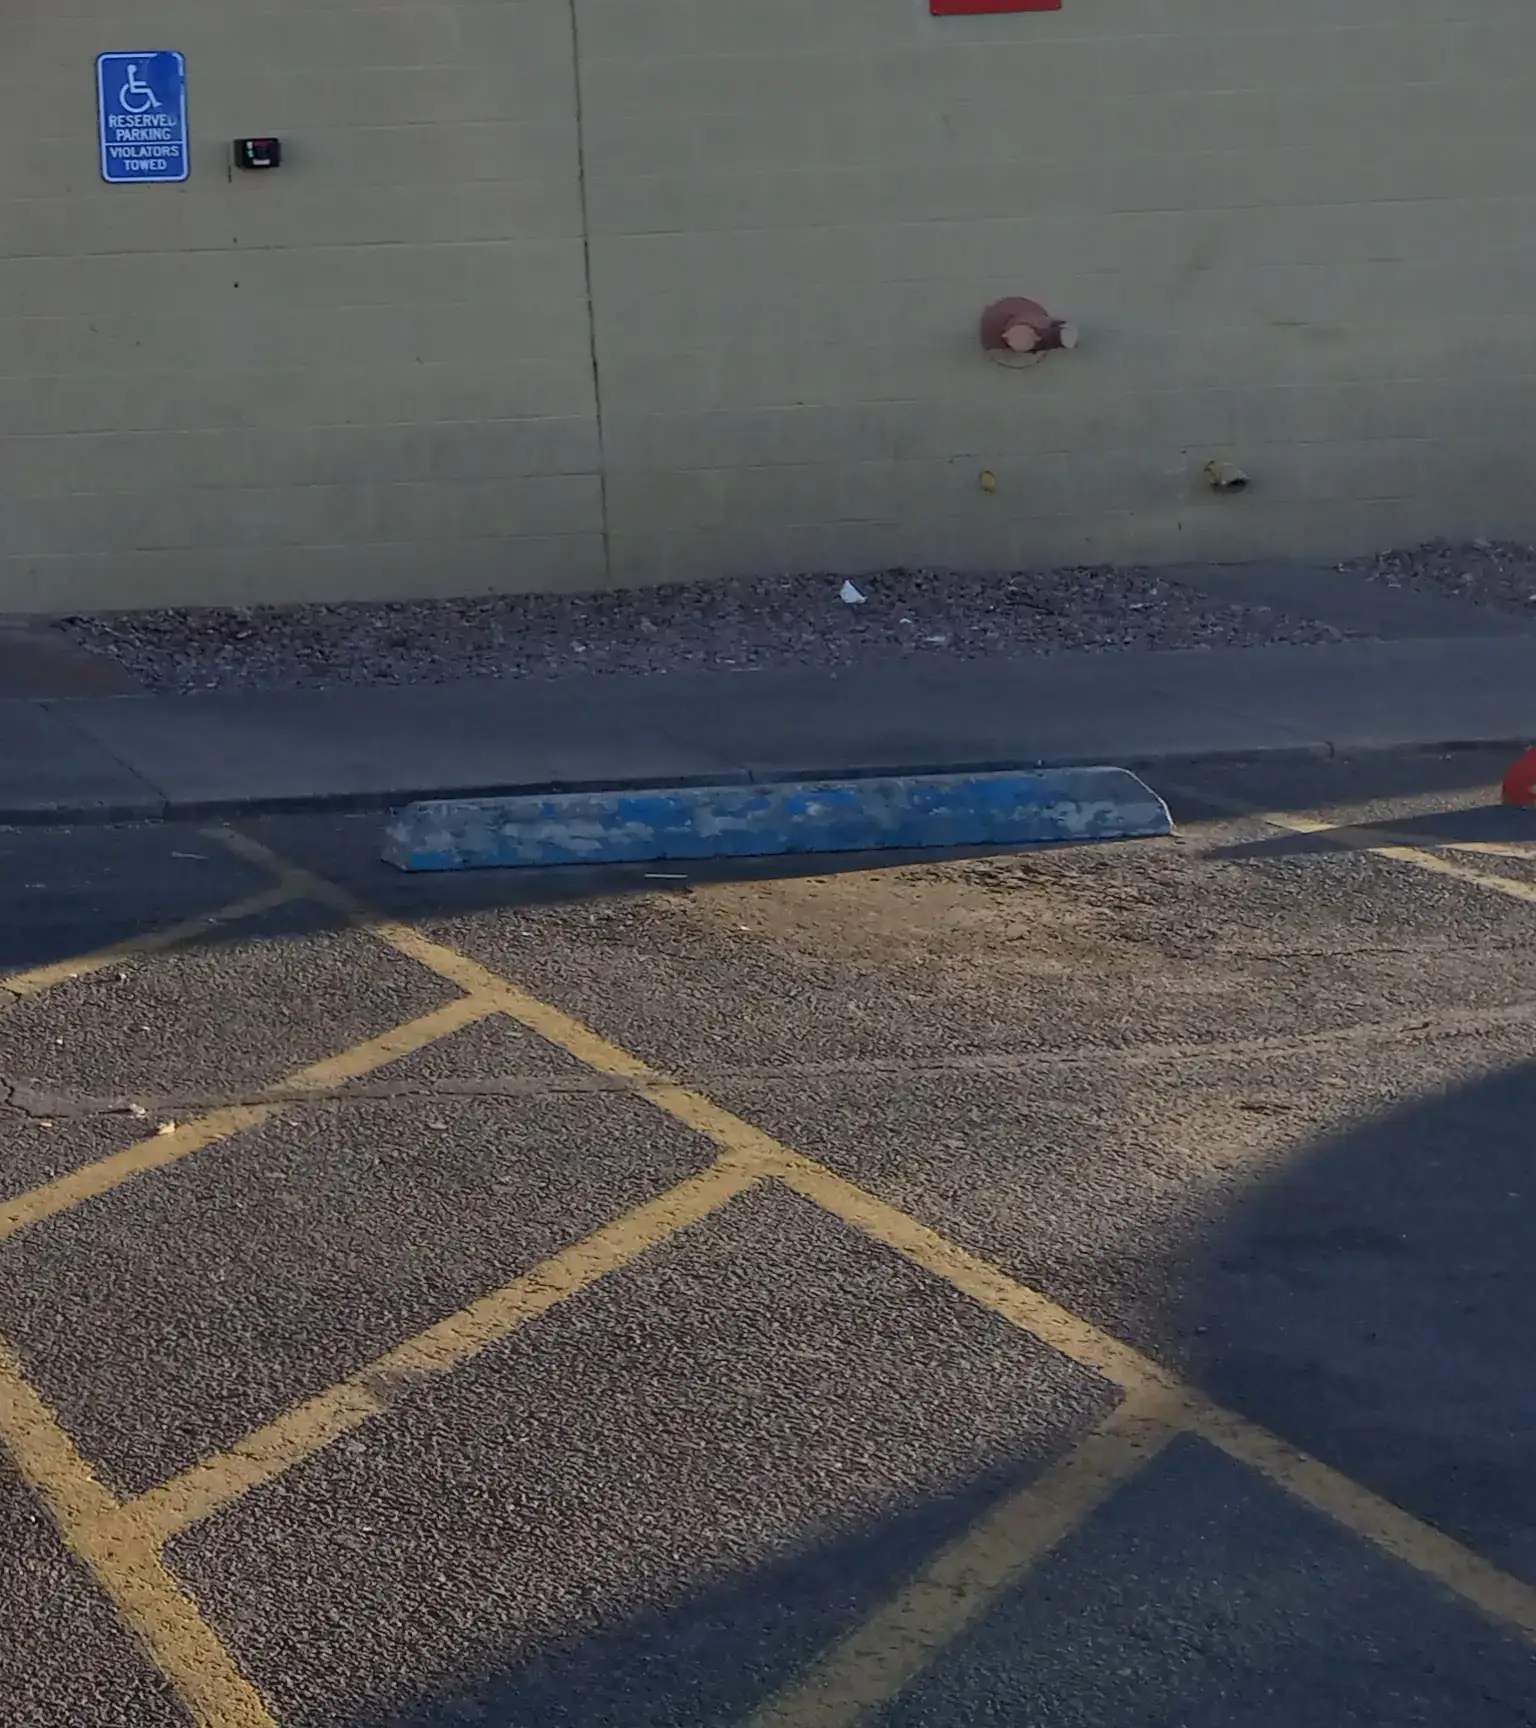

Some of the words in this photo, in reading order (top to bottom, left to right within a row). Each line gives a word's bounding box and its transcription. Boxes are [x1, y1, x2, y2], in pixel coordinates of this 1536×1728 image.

[109, 114, 177, 127] RESERVED
[116, 127, 171, 141] PARKING
[109, 145, 180, 158] VIOLATORS
[124, 159, 167, 171] TOWED
